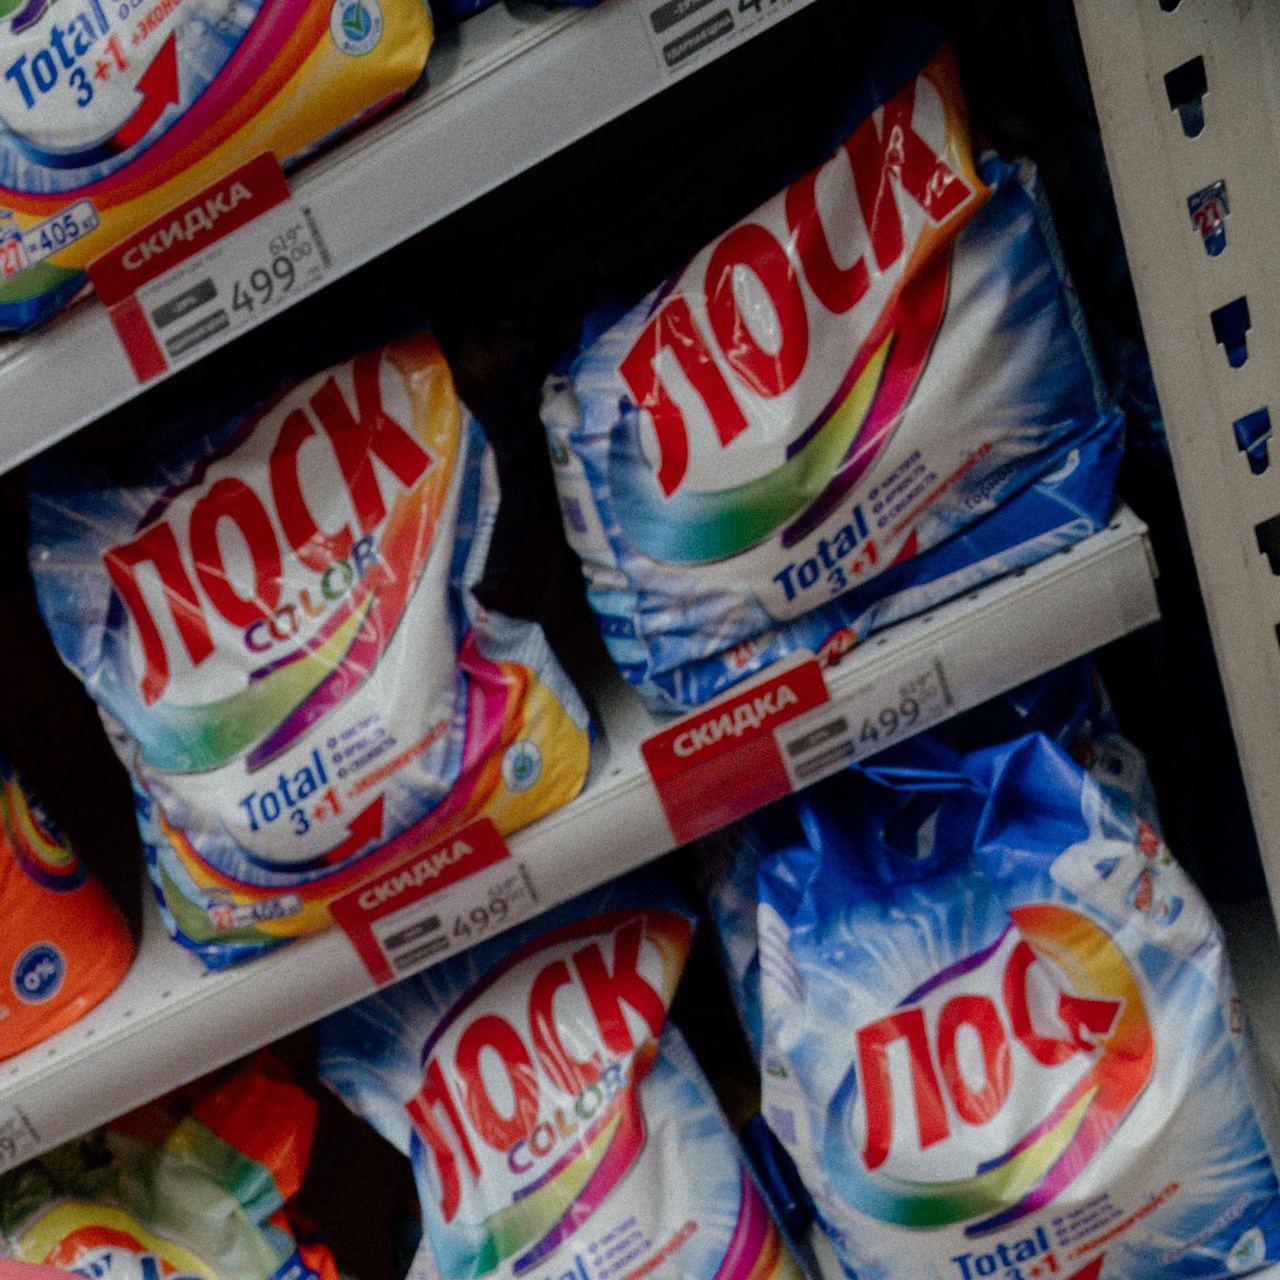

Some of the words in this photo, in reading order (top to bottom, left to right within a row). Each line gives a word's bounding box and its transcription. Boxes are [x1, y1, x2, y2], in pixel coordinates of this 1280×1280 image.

[4, 0, 110, 109] Total
[70, 33, 128, 108] 3+1
[120, 181, 254, 271] СКИДКА
[231, 256, 296, 313] 499
[619, 78, 976, 499] ЛОСК
[103, 352, 436, 706] ЛОСК
[772, 504, 869, 602] Total
[244, 534, 380, 652] COLOR
[672, 684, 799, 759] СКИДКА
[860, 699, 921, 745] 499
[239, 749, 328, 832] Total
[290, 786, 341, 836] 3+1
[357, 840, 473, 910] СКИДКА
[452, 899, 510, 937] 499
[24, 958, 57, 991] 0%
[405, 917, 666, 1225] ЛОСК
[508, 1063, 626, 1174] COLOR
